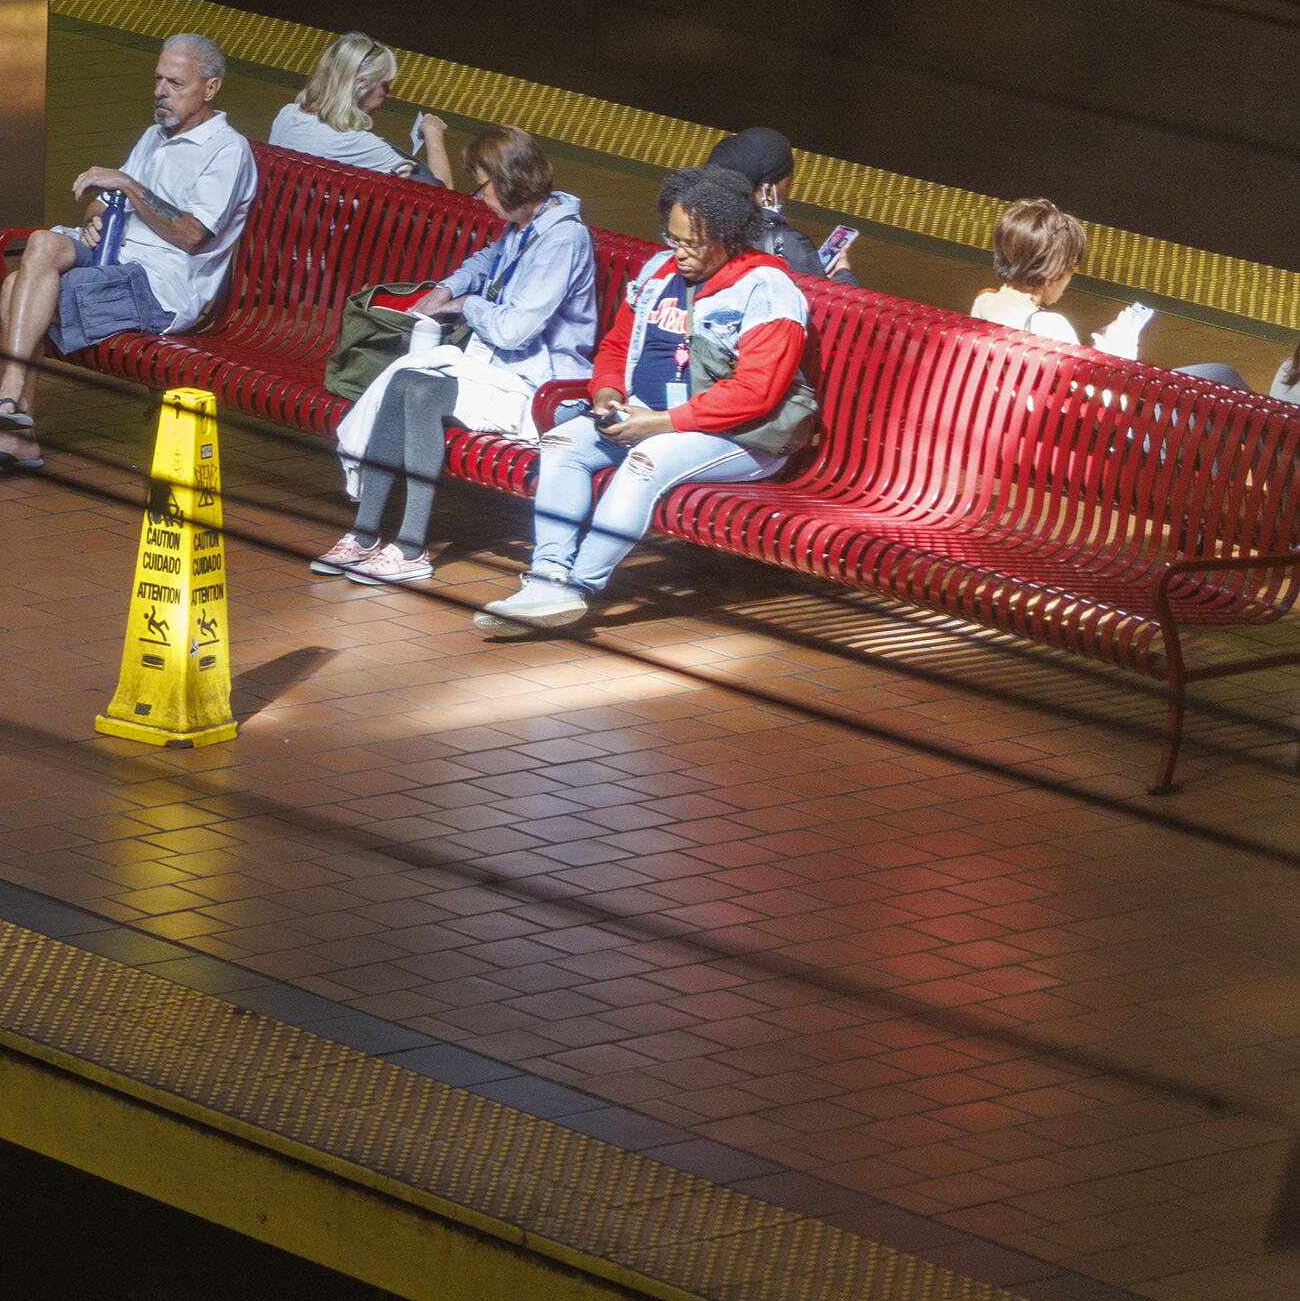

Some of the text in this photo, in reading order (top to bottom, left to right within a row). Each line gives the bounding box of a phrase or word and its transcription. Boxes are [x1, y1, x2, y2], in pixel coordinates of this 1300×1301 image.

[146, 527, 181, 551] CAUTION
[193, 530, 220, 552] CAUTION
[142, 552, 181, 575] CUIDADO
[192, 553, 222, 576] CUIDADO
[137, 581, 181, 605] ATTENTION
[191, 583, 224, 606] ATTENTION
